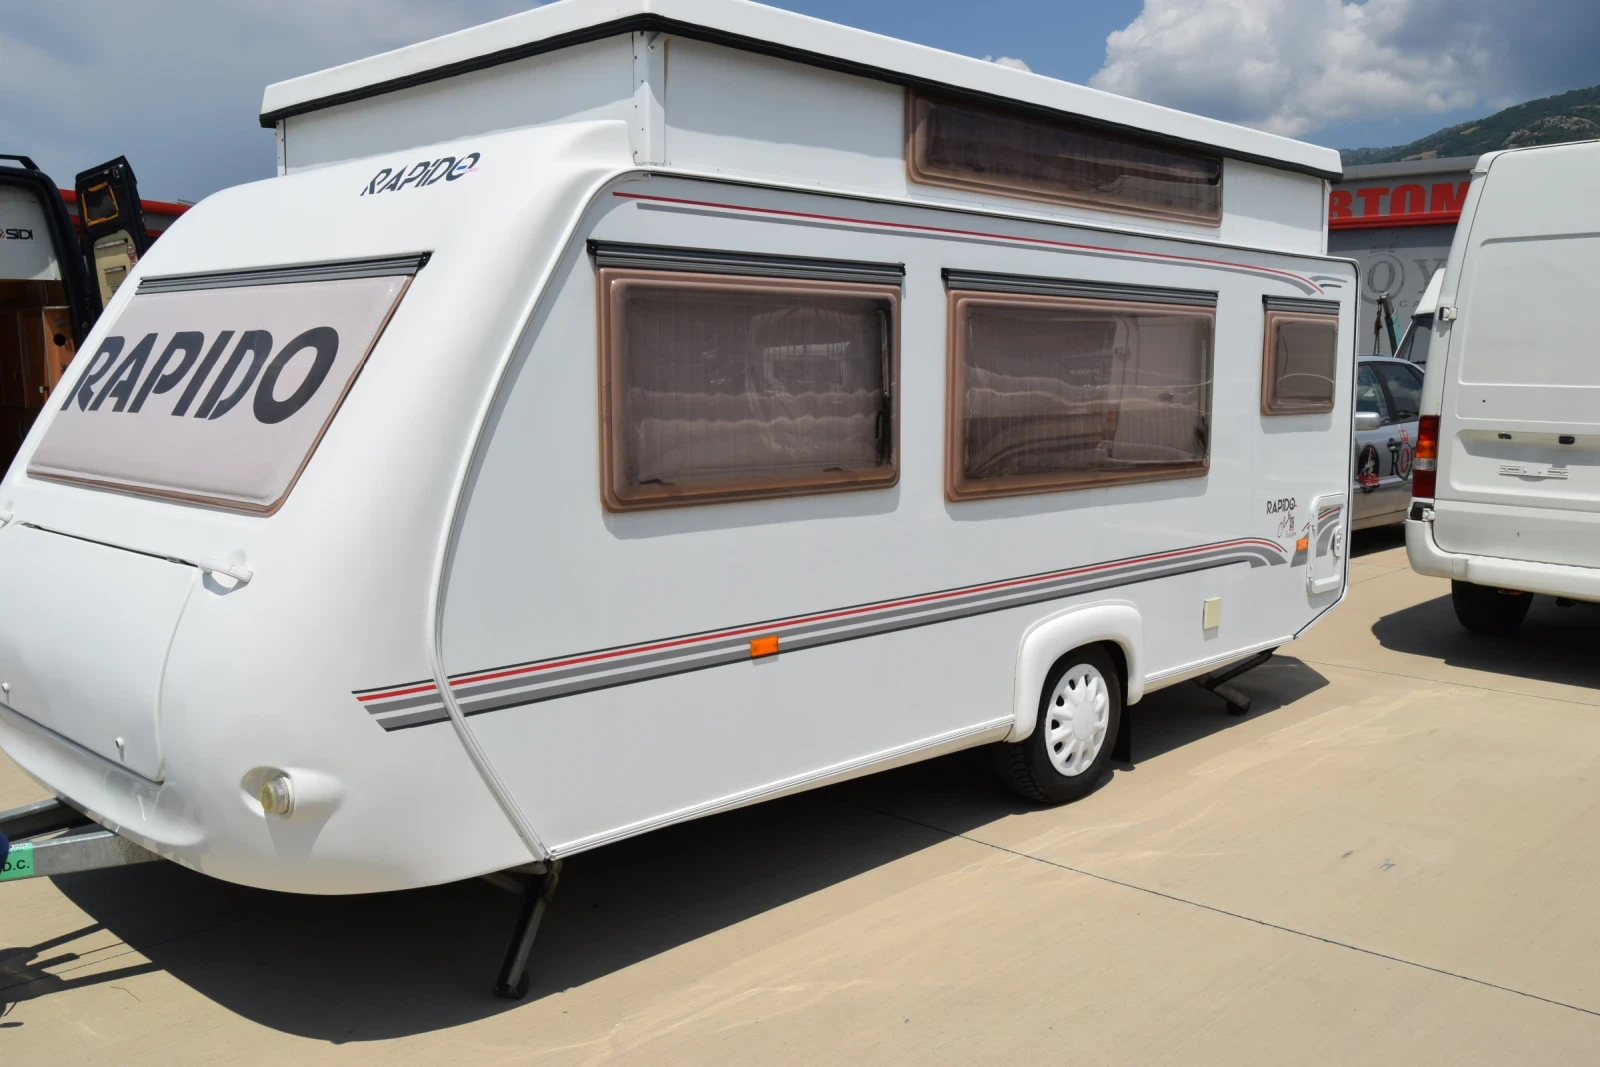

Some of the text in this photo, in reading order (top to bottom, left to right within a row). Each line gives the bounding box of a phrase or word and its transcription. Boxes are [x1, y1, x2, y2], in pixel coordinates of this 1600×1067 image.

[360, 152, 481, 196] RAPIDO
[60, 326, 340, 424] RAPIDO
[1266, 497, 1297, 515] RAPIDO
